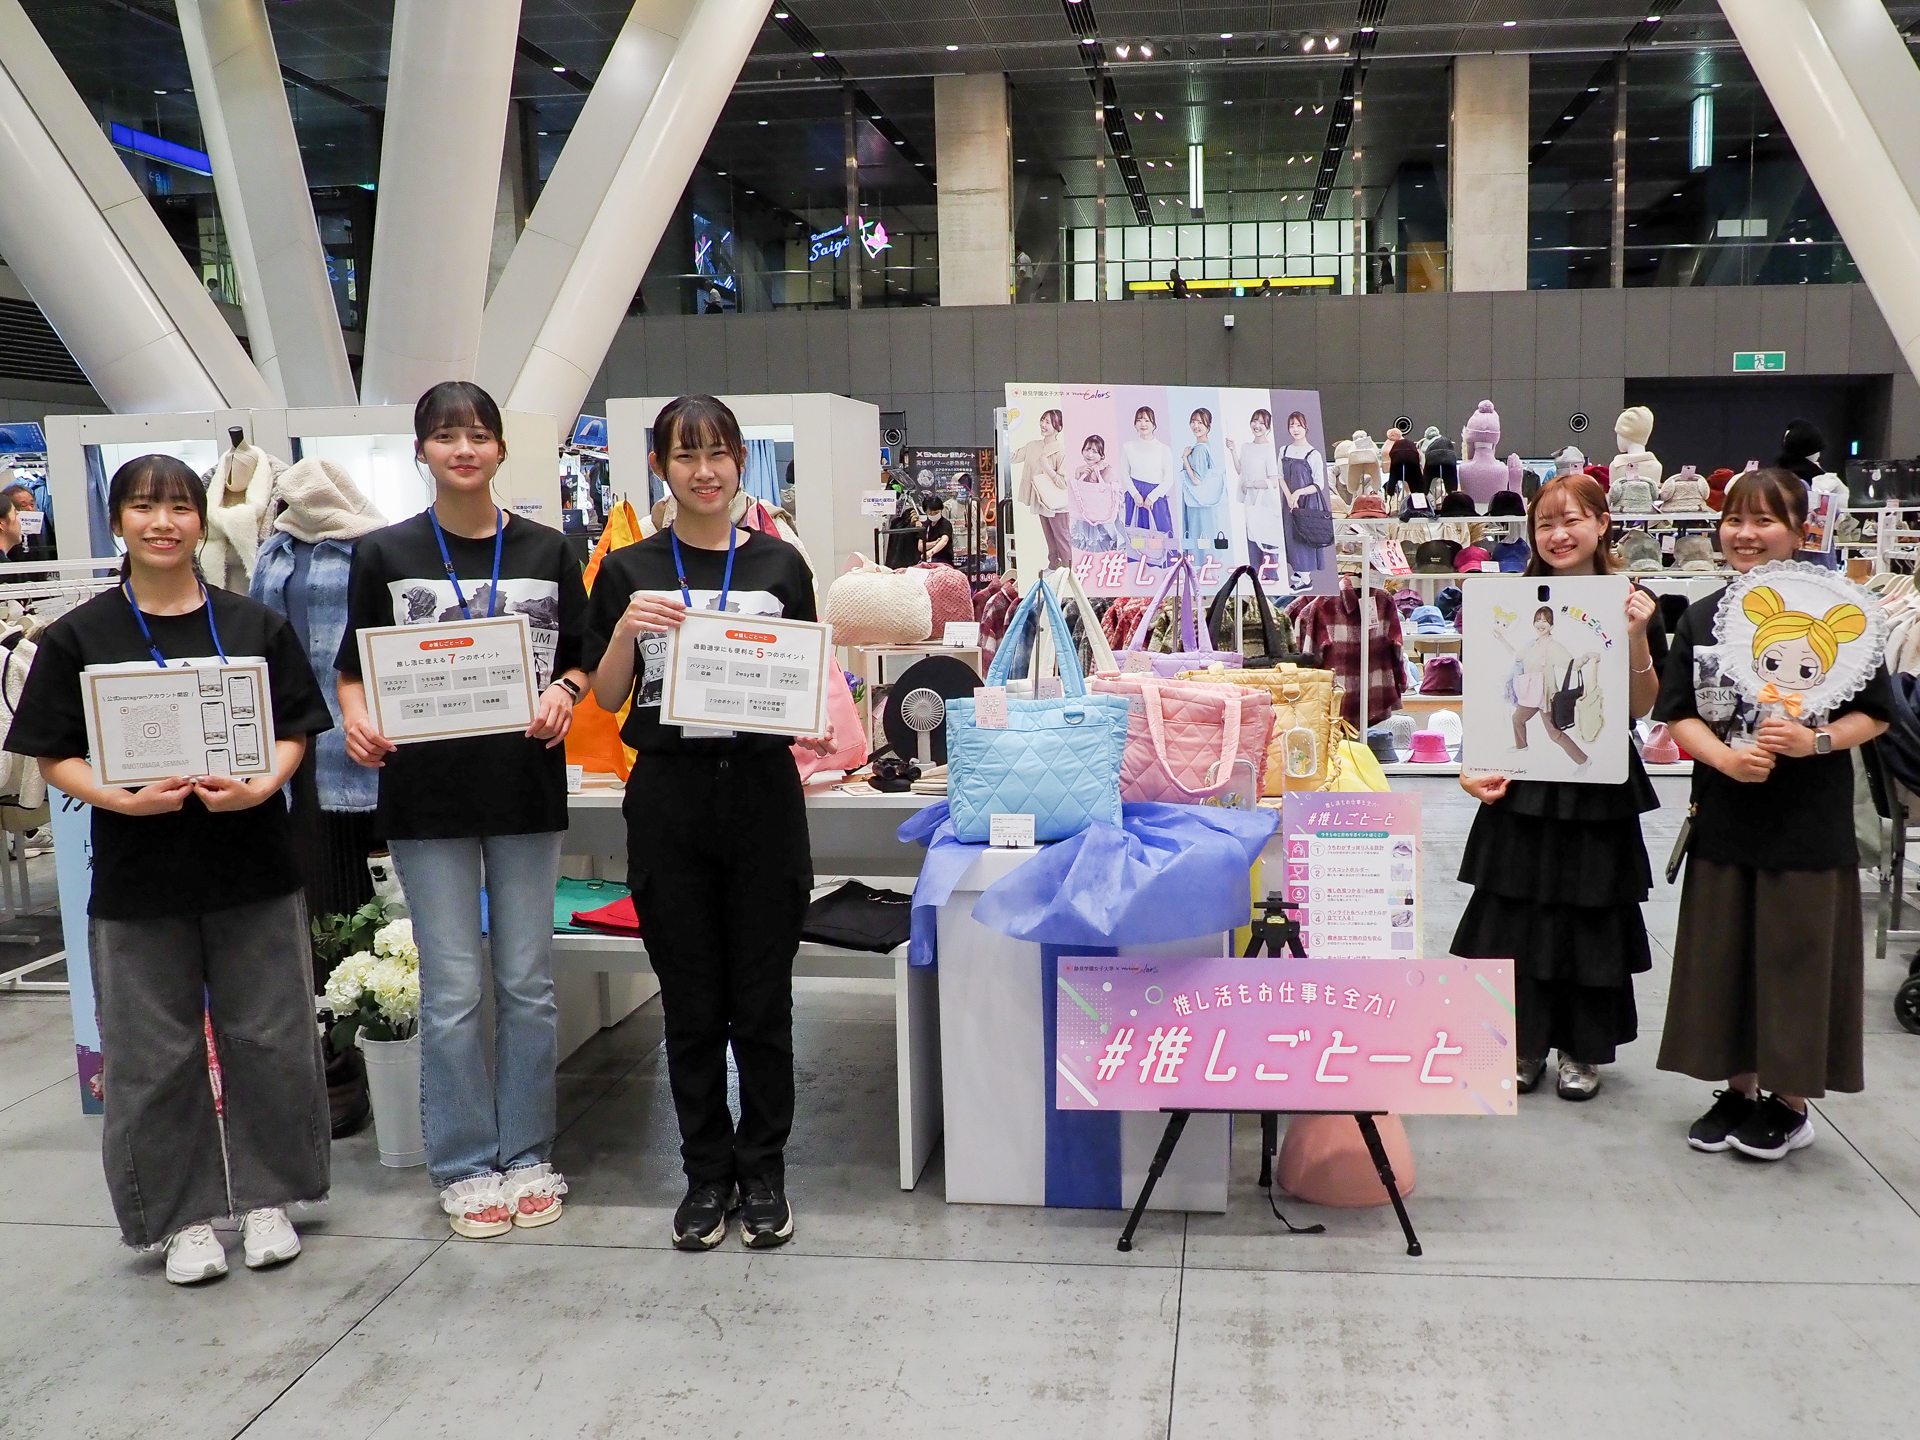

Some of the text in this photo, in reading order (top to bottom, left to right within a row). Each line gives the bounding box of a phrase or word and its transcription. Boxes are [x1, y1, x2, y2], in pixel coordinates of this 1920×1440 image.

[1307, 811, 1395, 826] #推しごとーと
[1173, 981, 1396, 1019] 推し活もお仕事も全力!
[1096, 1026, 1463, 1084] #推しごとーと
